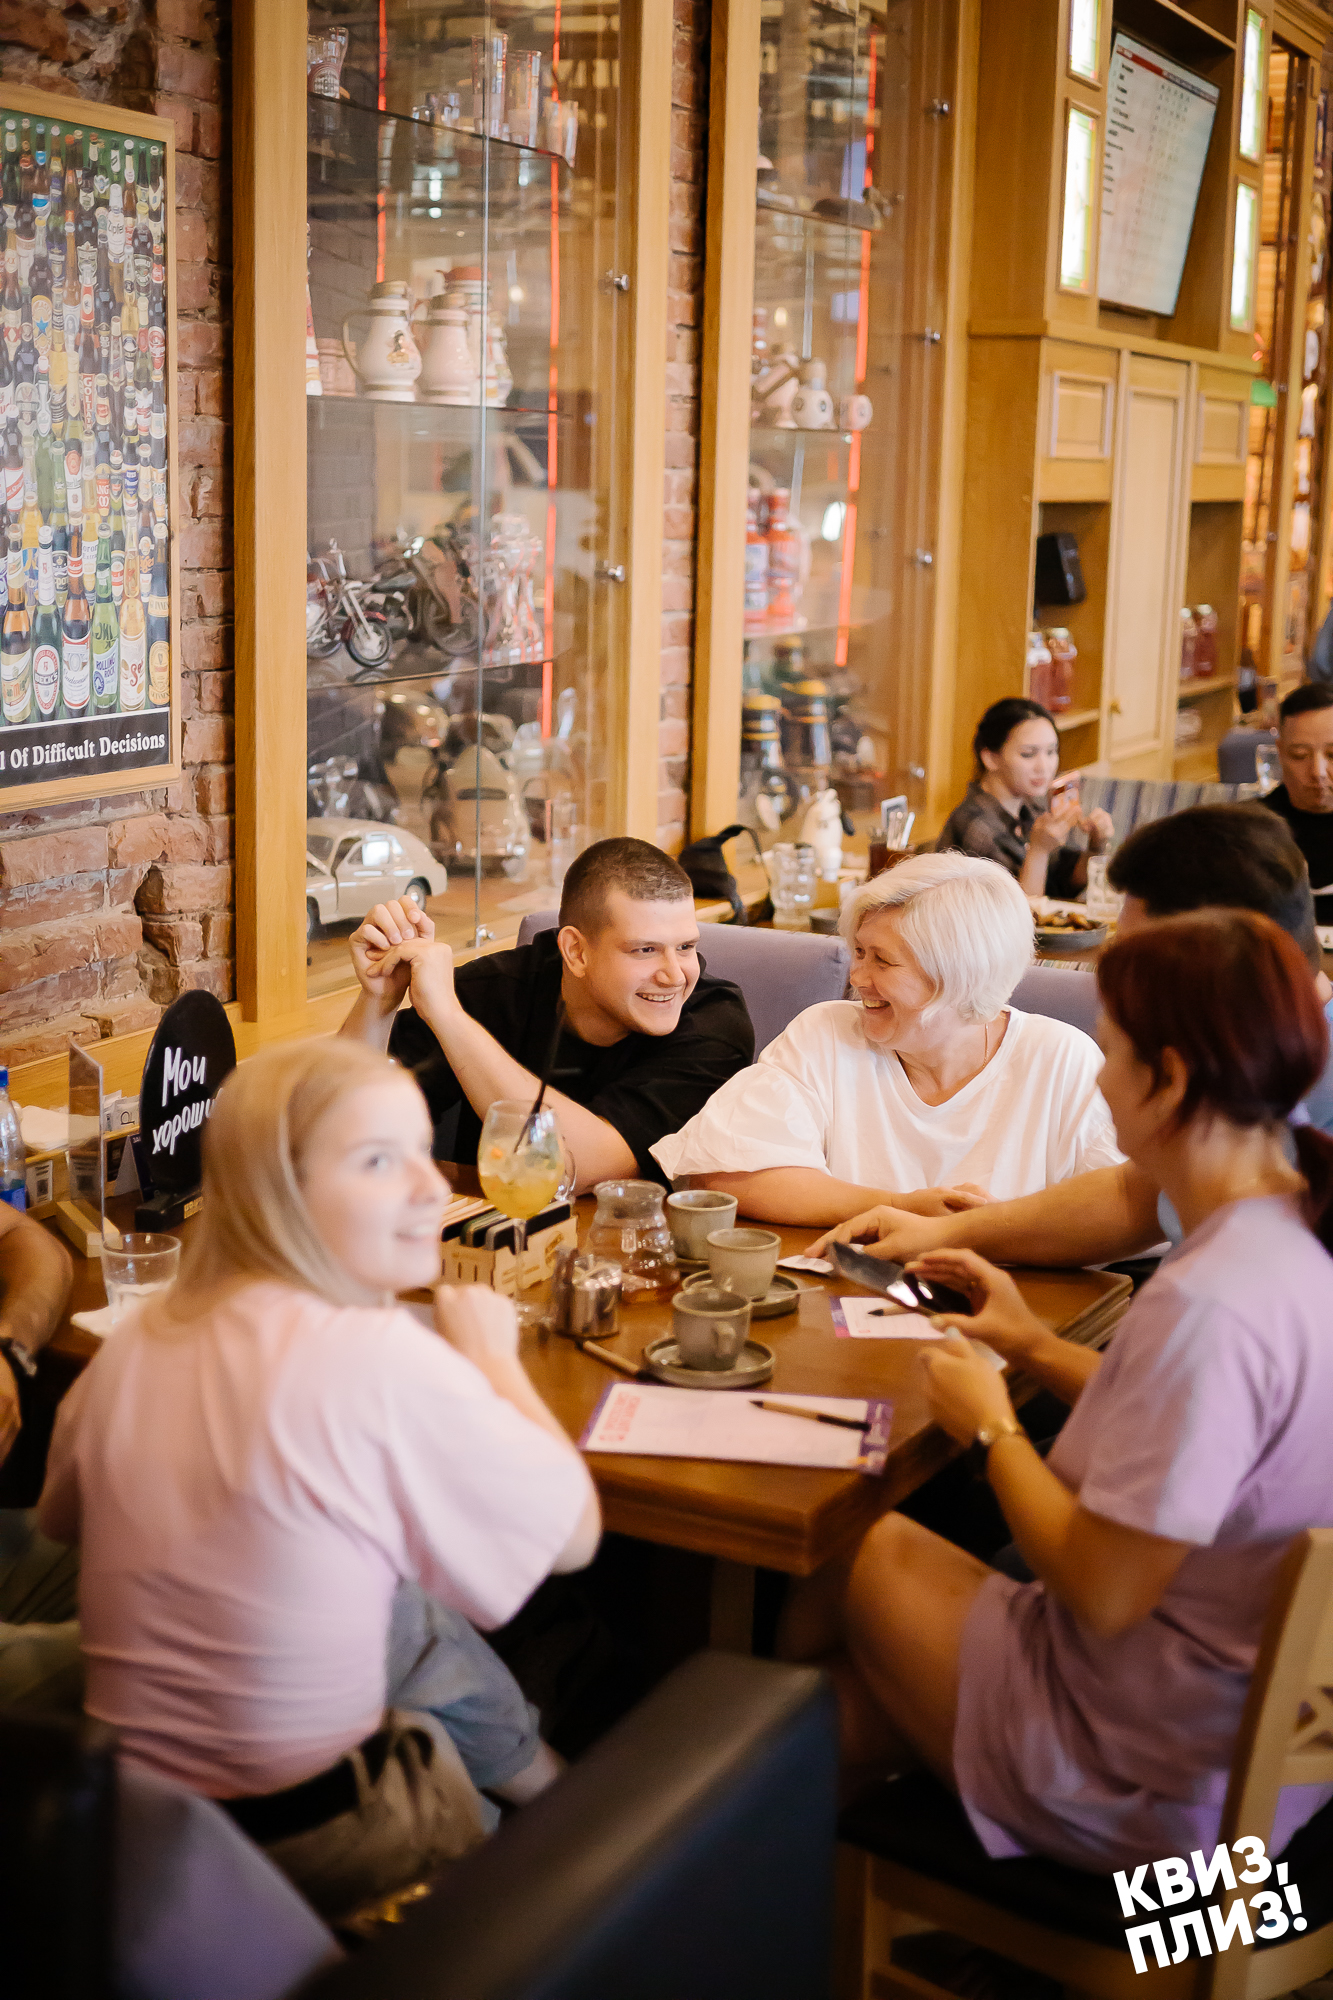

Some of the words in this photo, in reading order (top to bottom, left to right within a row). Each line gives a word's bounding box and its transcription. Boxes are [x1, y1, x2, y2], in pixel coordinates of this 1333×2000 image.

[10, 746, 29, 769] Of
[32, 738, 95, 766] Difficult
[99, 731, 165, 757] Decisions
[162, 1046, 206, 1107] Мои
